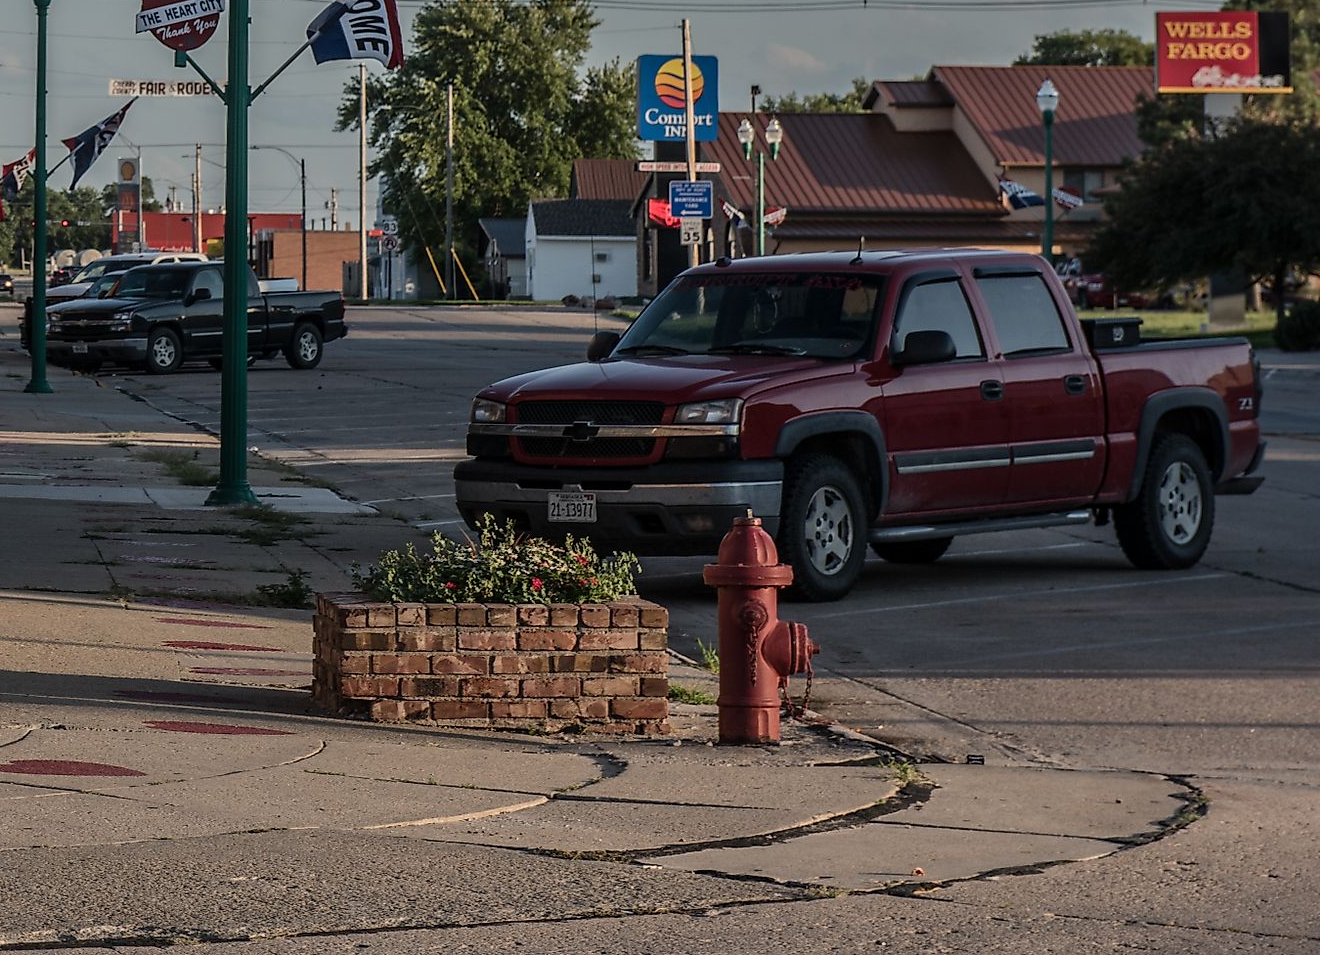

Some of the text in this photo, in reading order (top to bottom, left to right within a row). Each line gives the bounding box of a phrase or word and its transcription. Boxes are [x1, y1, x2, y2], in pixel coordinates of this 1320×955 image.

[140, 11, 162, 27] THE
[165, 3, 198, 21] HEART
[156, 18, 217, 40] Thank You
[1165, 22, 1252, 39] WELLS
[1166, 42, 1251, 60] FARGO
[139, 82, 166, 95] FAIR
[683, 232, 700, 242] 35
[551, 503, 593, 518] 21-13977
